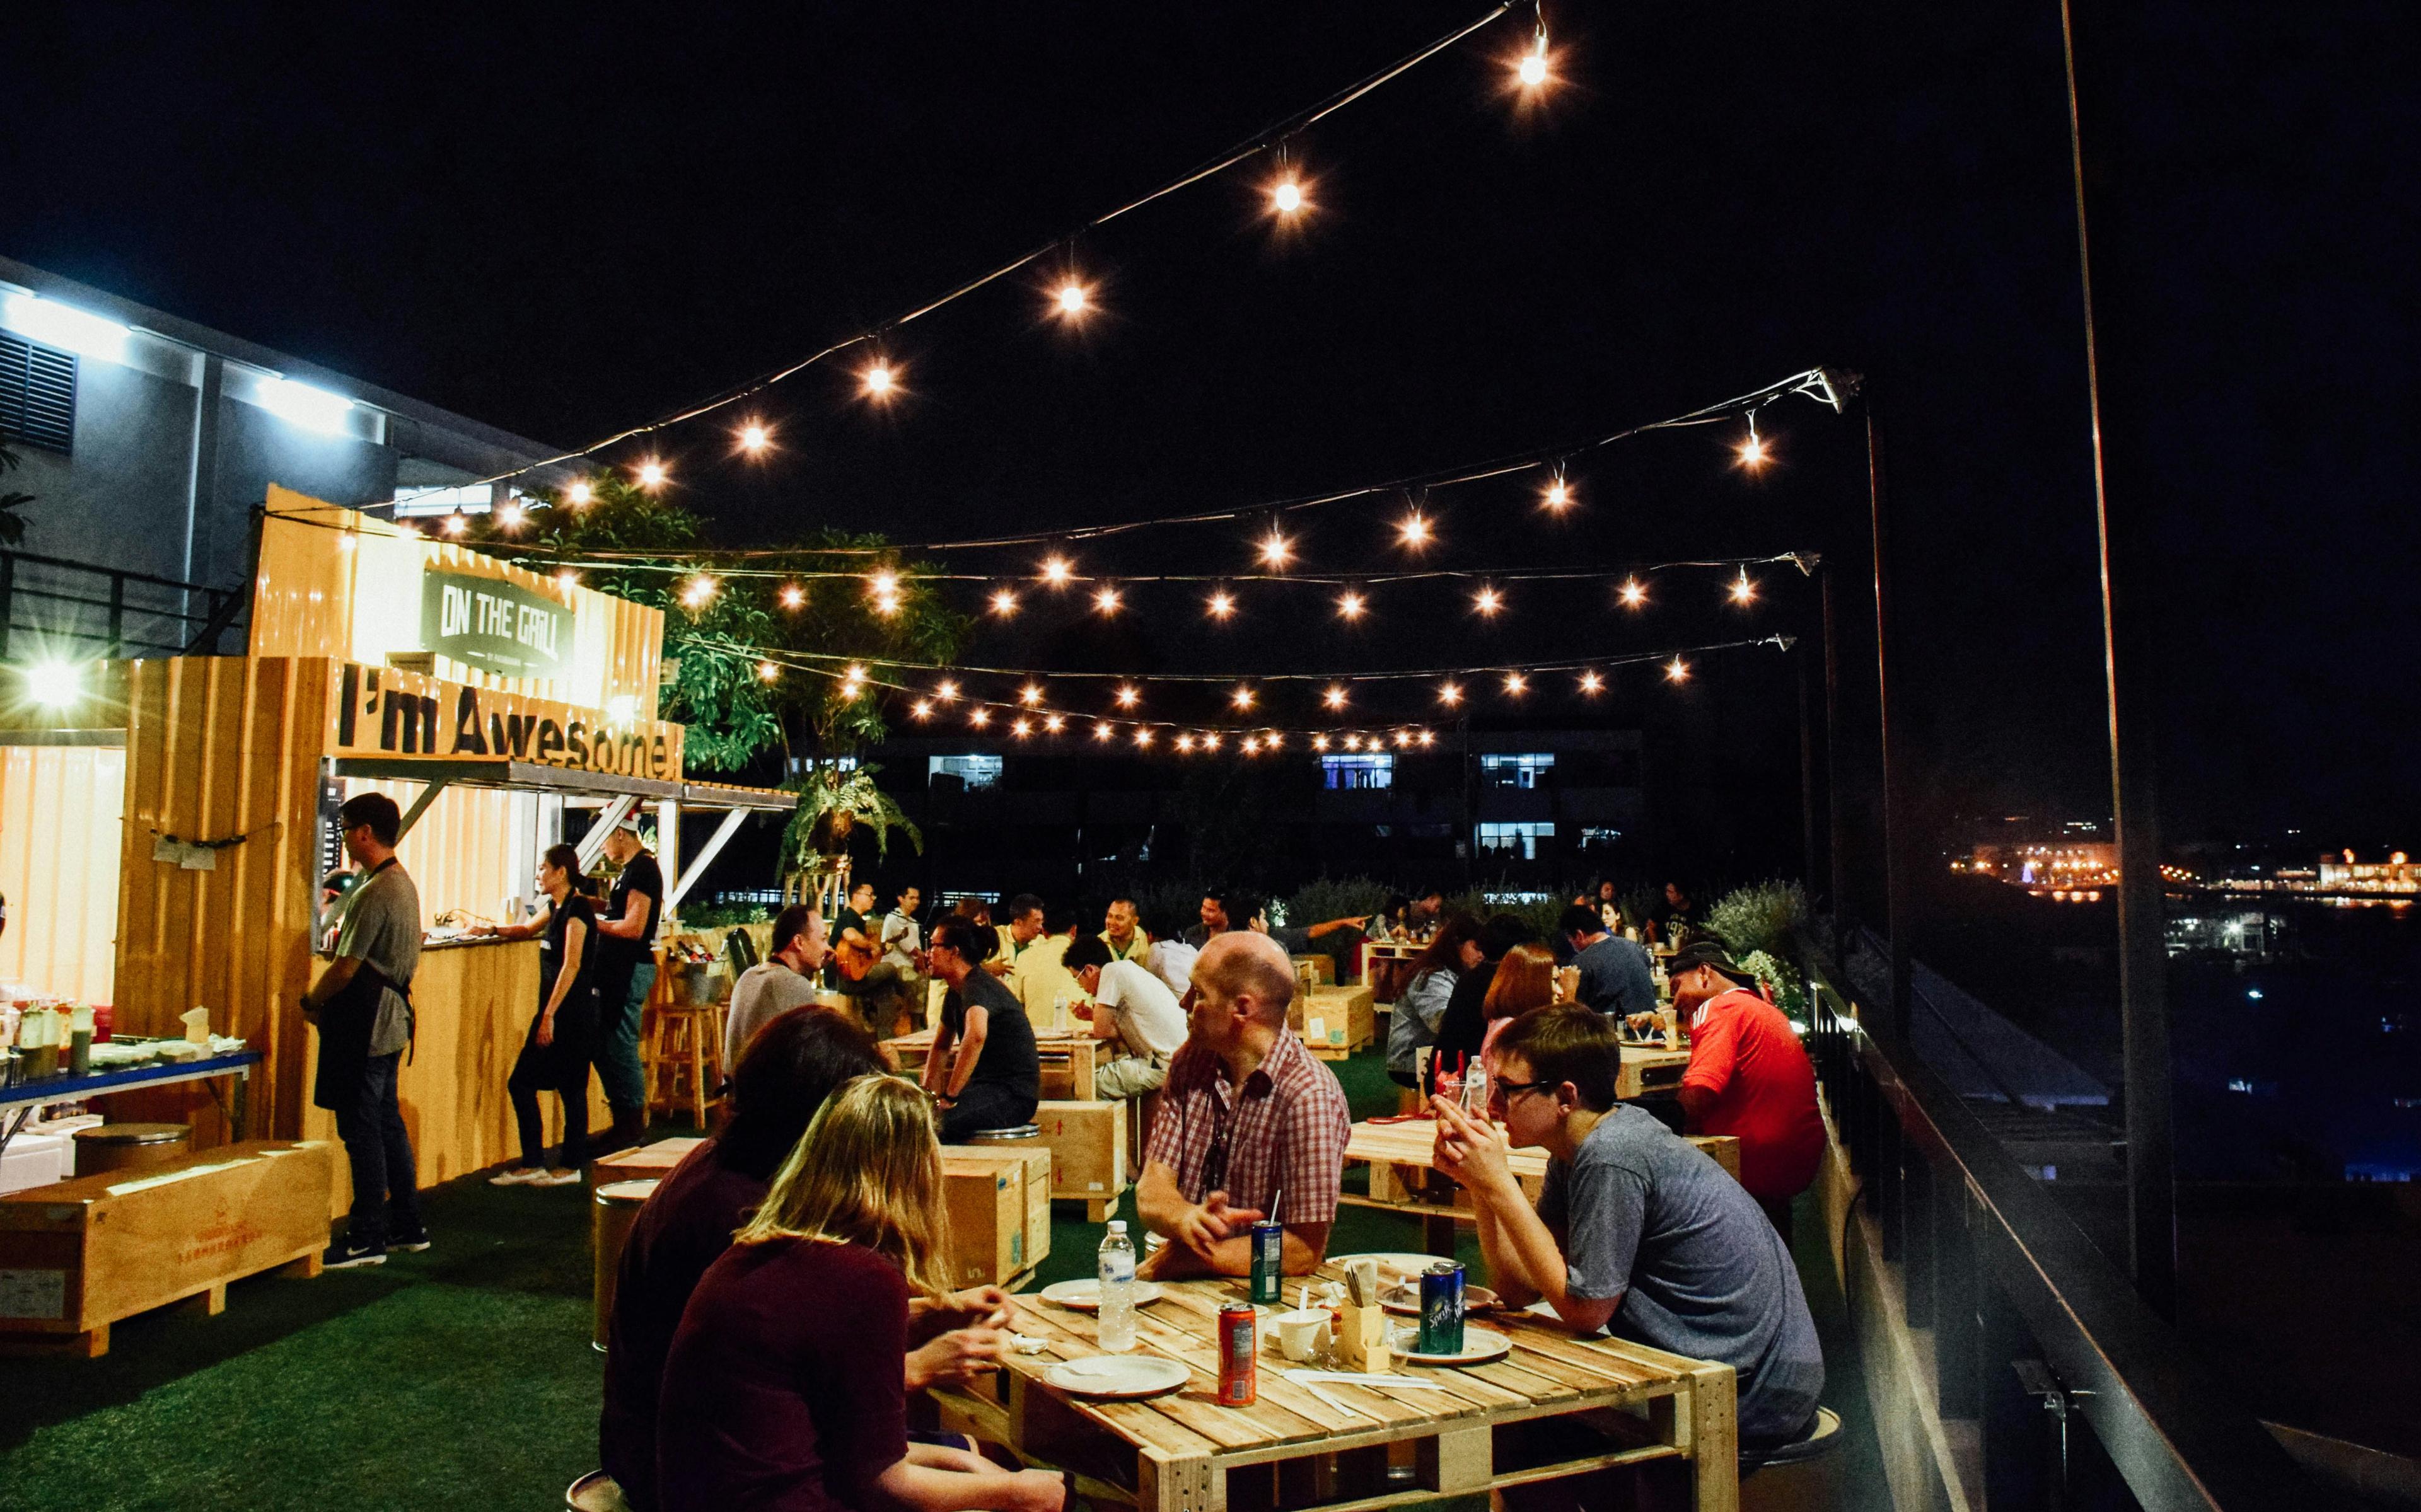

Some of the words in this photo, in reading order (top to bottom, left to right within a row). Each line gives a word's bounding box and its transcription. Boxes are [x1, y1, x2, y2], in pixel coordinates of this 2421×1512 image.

[441, 584, 472, 638] ON
[476, 592, 514, 639] THE
[339, 663, 439, 754] I'm
